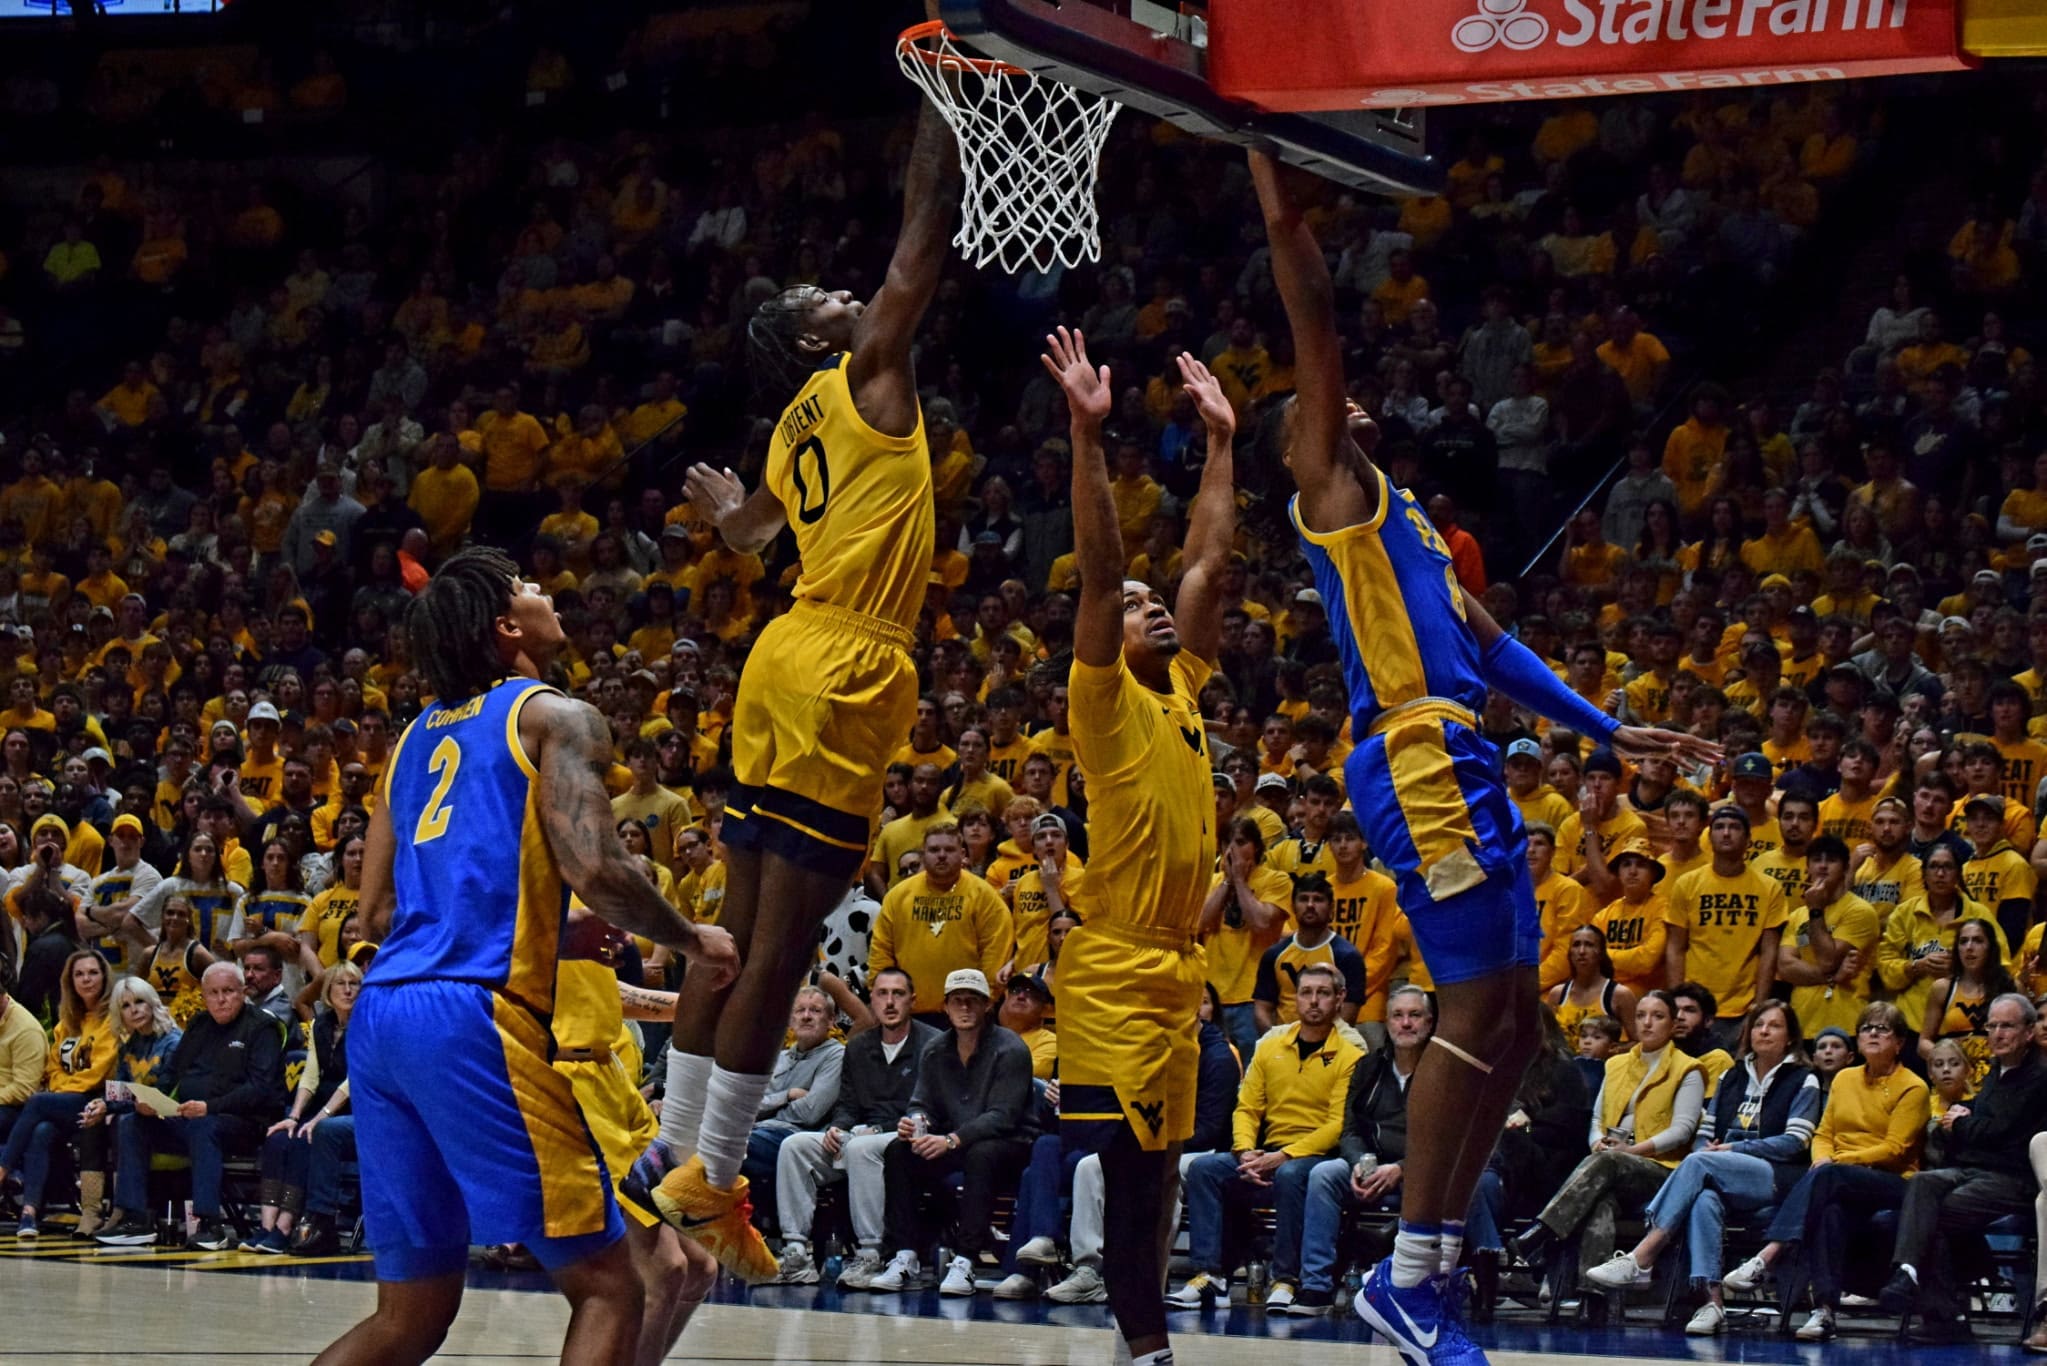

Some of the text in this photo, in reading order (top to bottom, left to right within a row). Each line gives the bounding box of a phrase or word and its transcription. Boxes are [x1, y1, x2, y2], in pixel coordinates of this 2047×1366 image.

[793, 433, 829, 524] 0
[413, 734, 462, 846] 2
[1700, 893, 1759, 910] BEAT
[1700, 910, 1759, 926] PITT
